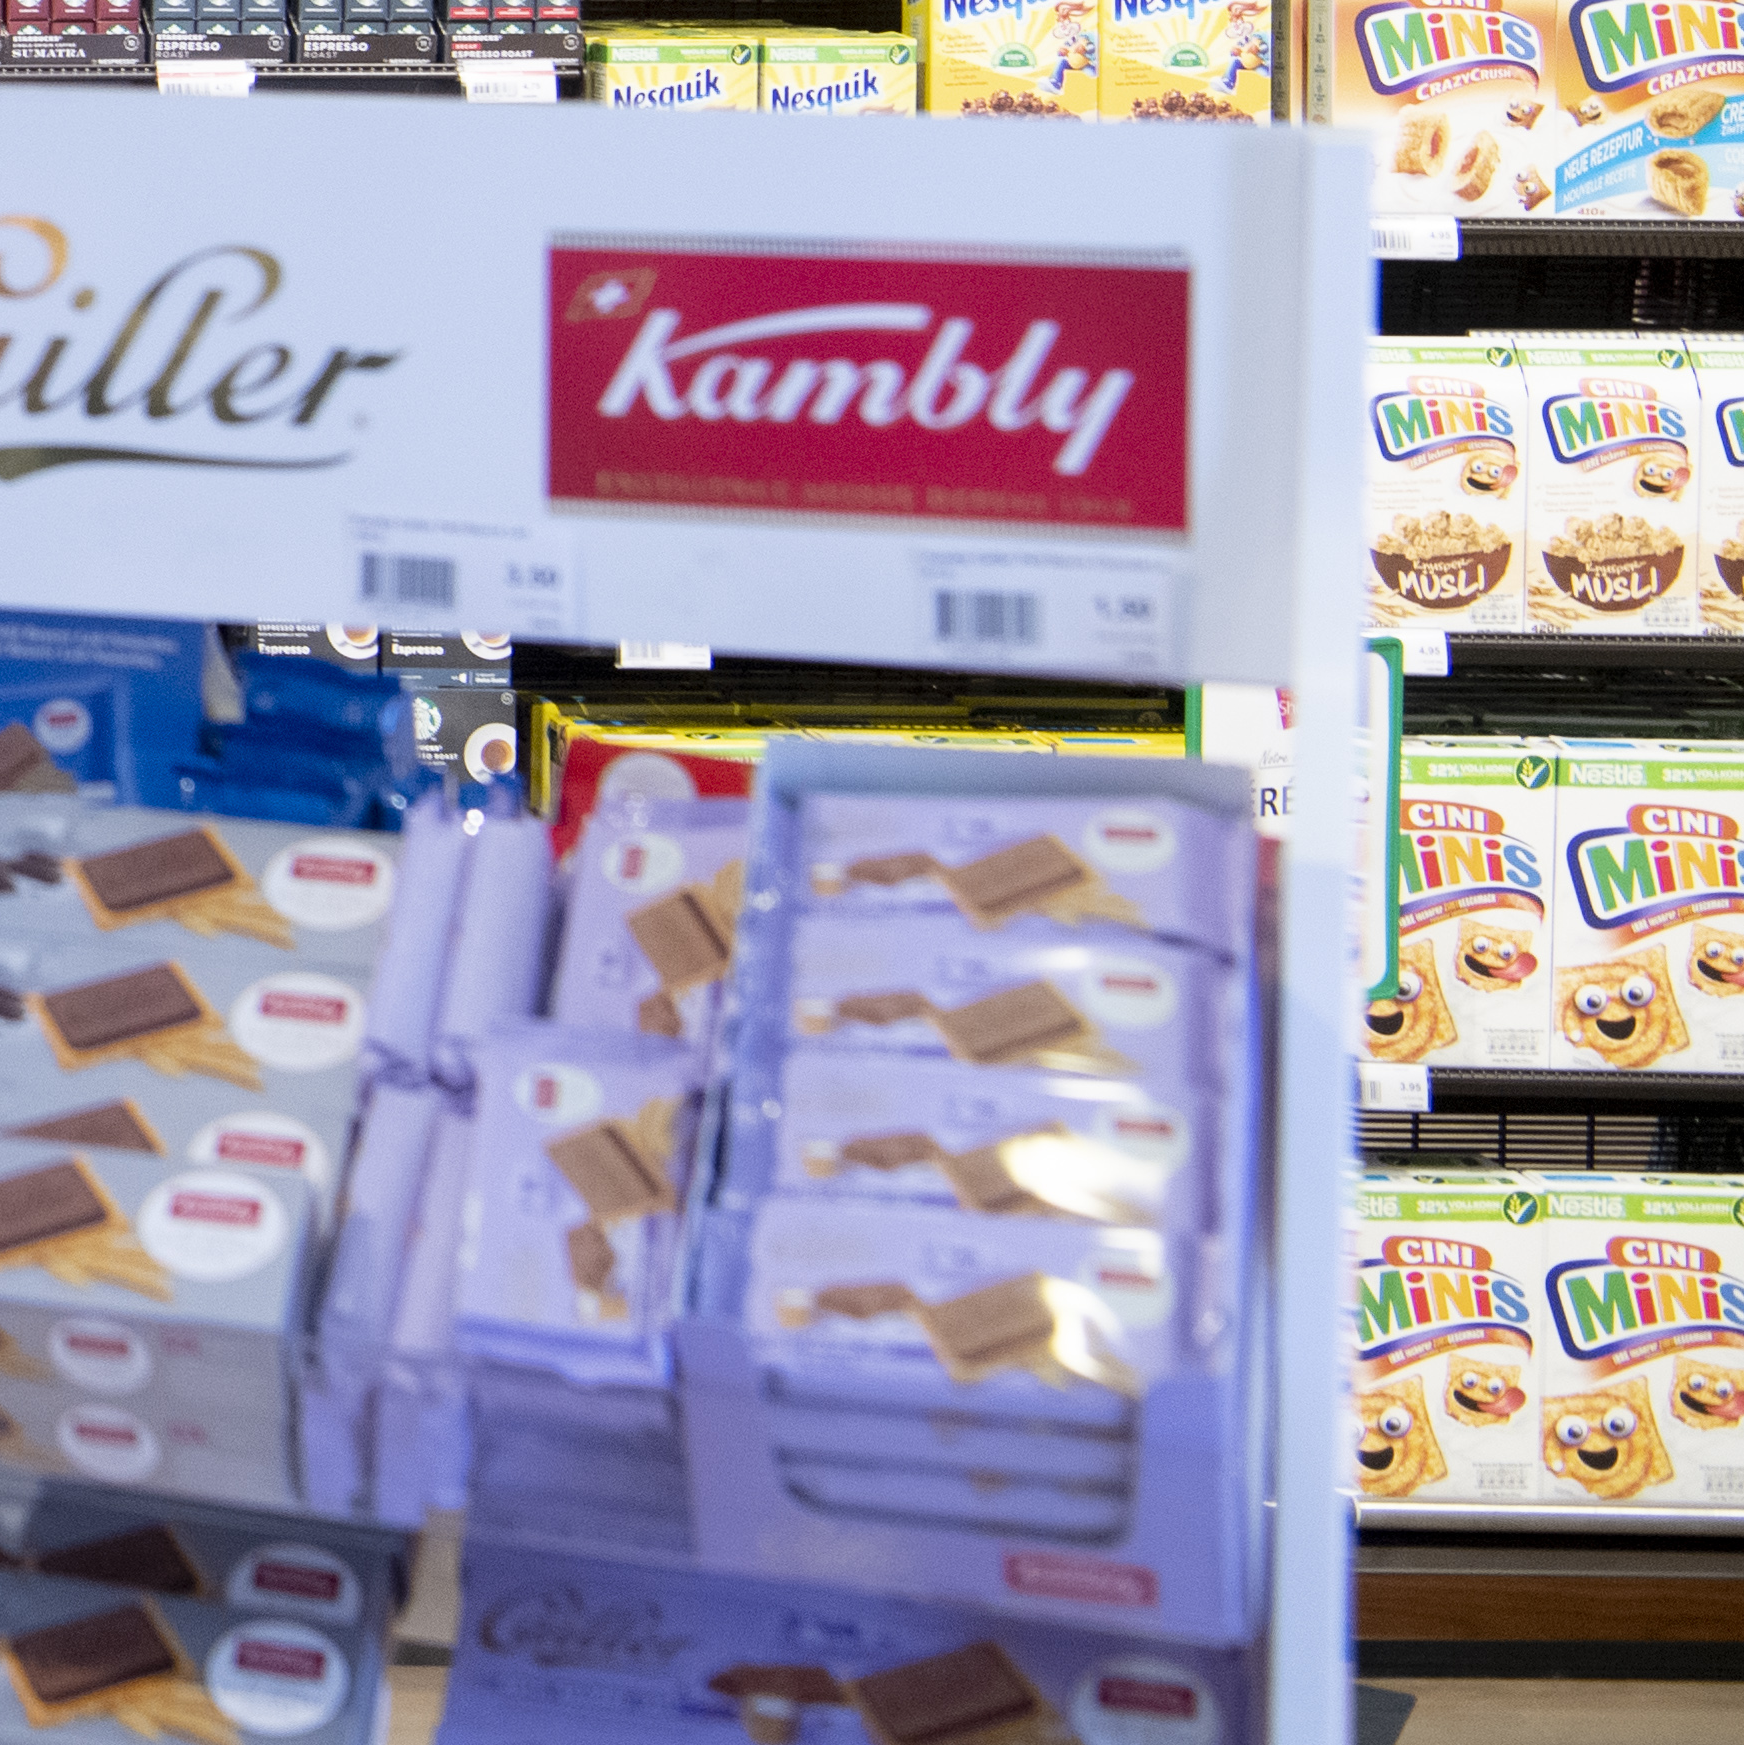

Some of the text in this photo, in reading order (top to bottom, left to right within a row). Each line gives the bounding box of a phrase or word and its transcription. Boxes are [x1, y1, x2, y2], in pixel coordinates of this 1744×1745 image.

[614, 68, 721, 114] Nesquik
[1563, 127, 1644, 183] NEUE REZEPTUR
[599, 302, 1136, 475] Kambly
[1416, 377, 1473, 397] CINI
[1588, 379, 1645, 399] CINI
[258, 642, 311, 656] Espresso
[1569, 763, 1644, 785] Nestlé
[1409, 804, 1487, 831] CINI
[1642, 810, 1720, 837] CINI
[1549, 1195, 1622, 1218] Nestlé
[1398, 1241, 1475, 1268] CINI
